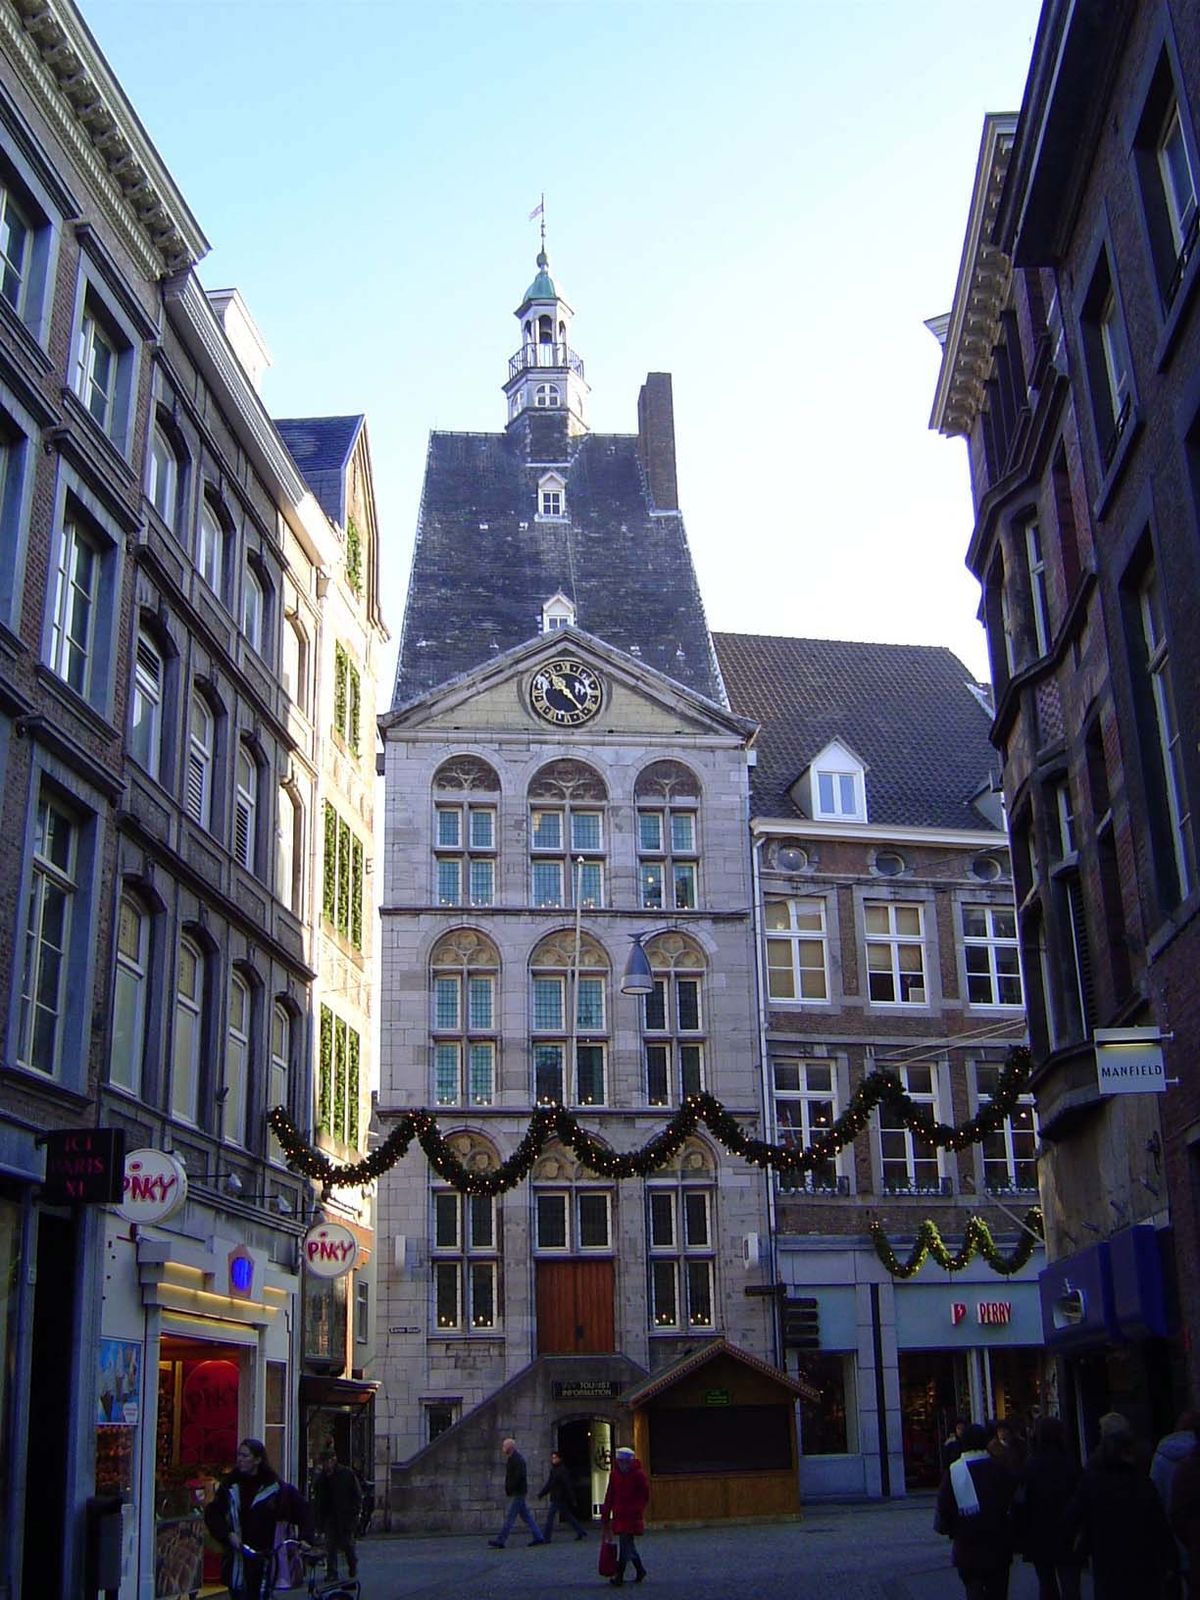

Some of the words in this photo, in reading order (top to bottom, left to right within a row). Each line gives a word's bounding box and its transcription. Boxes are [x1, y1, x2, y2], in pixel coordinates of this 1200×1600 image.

[1101, 1065, 1162, 1077] MANFIELD
[307, 1231, 353, 1262] PINKY
[978, 1302, 1011, 1324] PERRY
